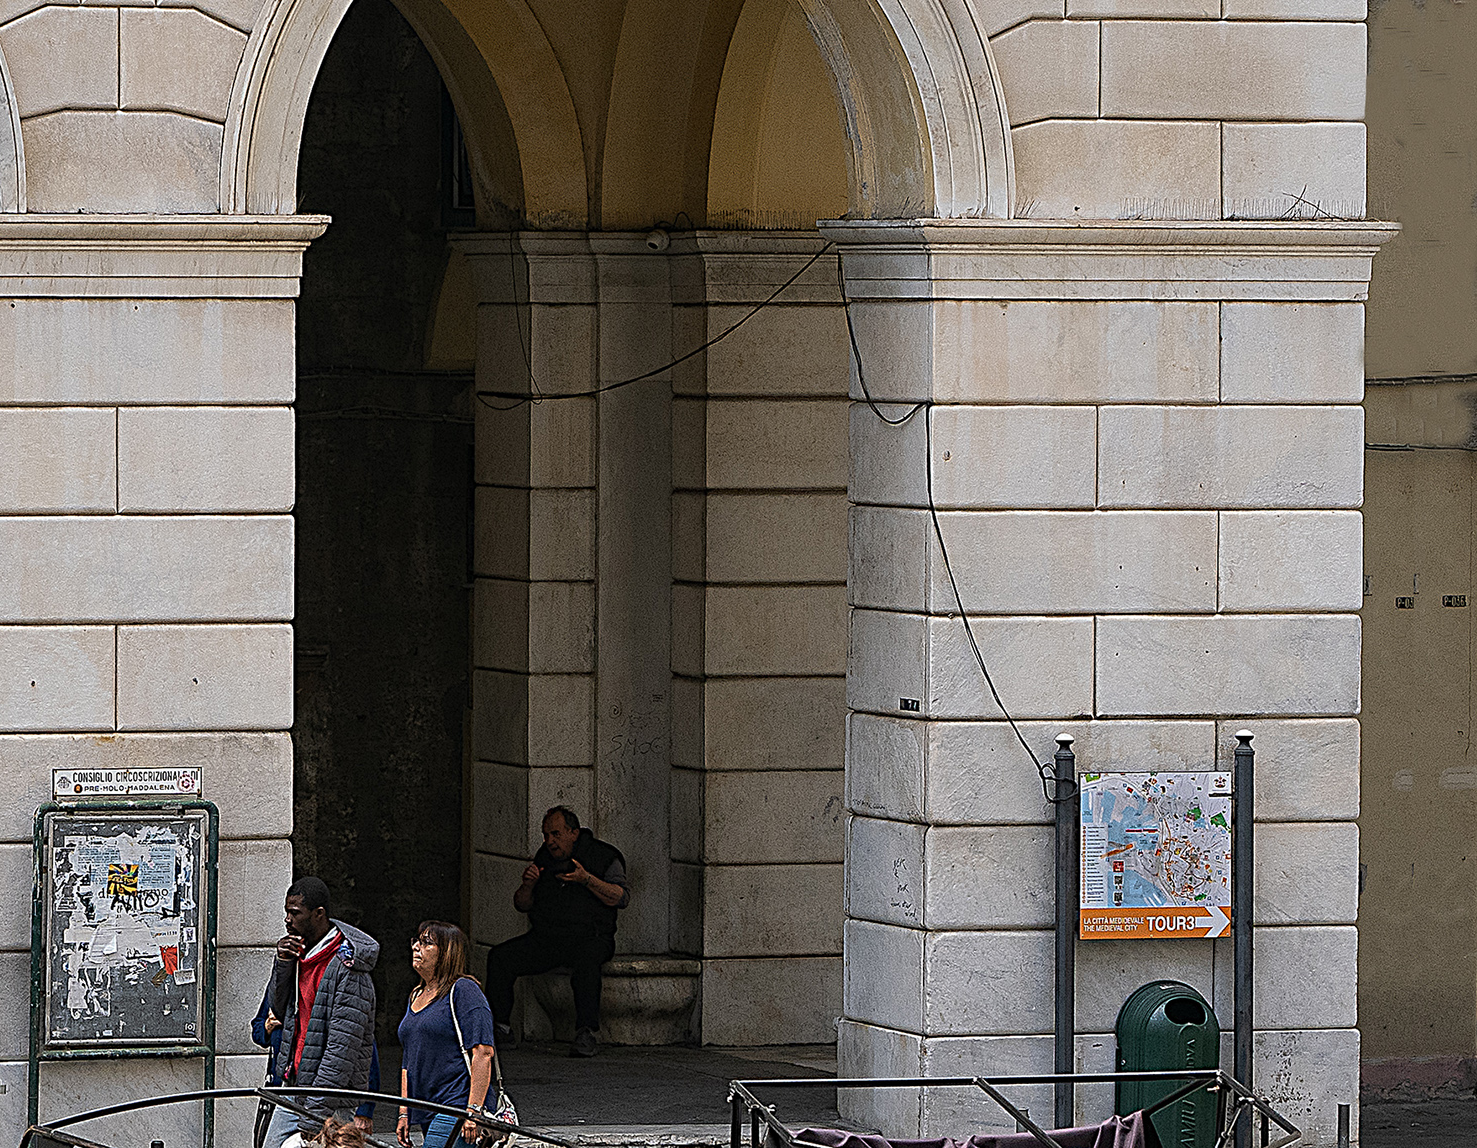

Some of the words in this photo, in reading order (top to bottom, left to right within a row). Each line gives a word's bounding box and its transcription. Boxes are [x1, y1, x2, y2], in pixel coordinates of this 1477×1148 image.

[72, 771, 113, 783] CONSIGLIO
[1083, 917, 1091, 925] LA
[1092, 915, 1109, 925] CITTÀ
[1146, 915, 1196, 931] TOUR3
[1083, 924, 1095, 932] THE
[1096, 924, 1125, 932] MEDIEVAL
[1125, 924, 1139, 932] CITY
